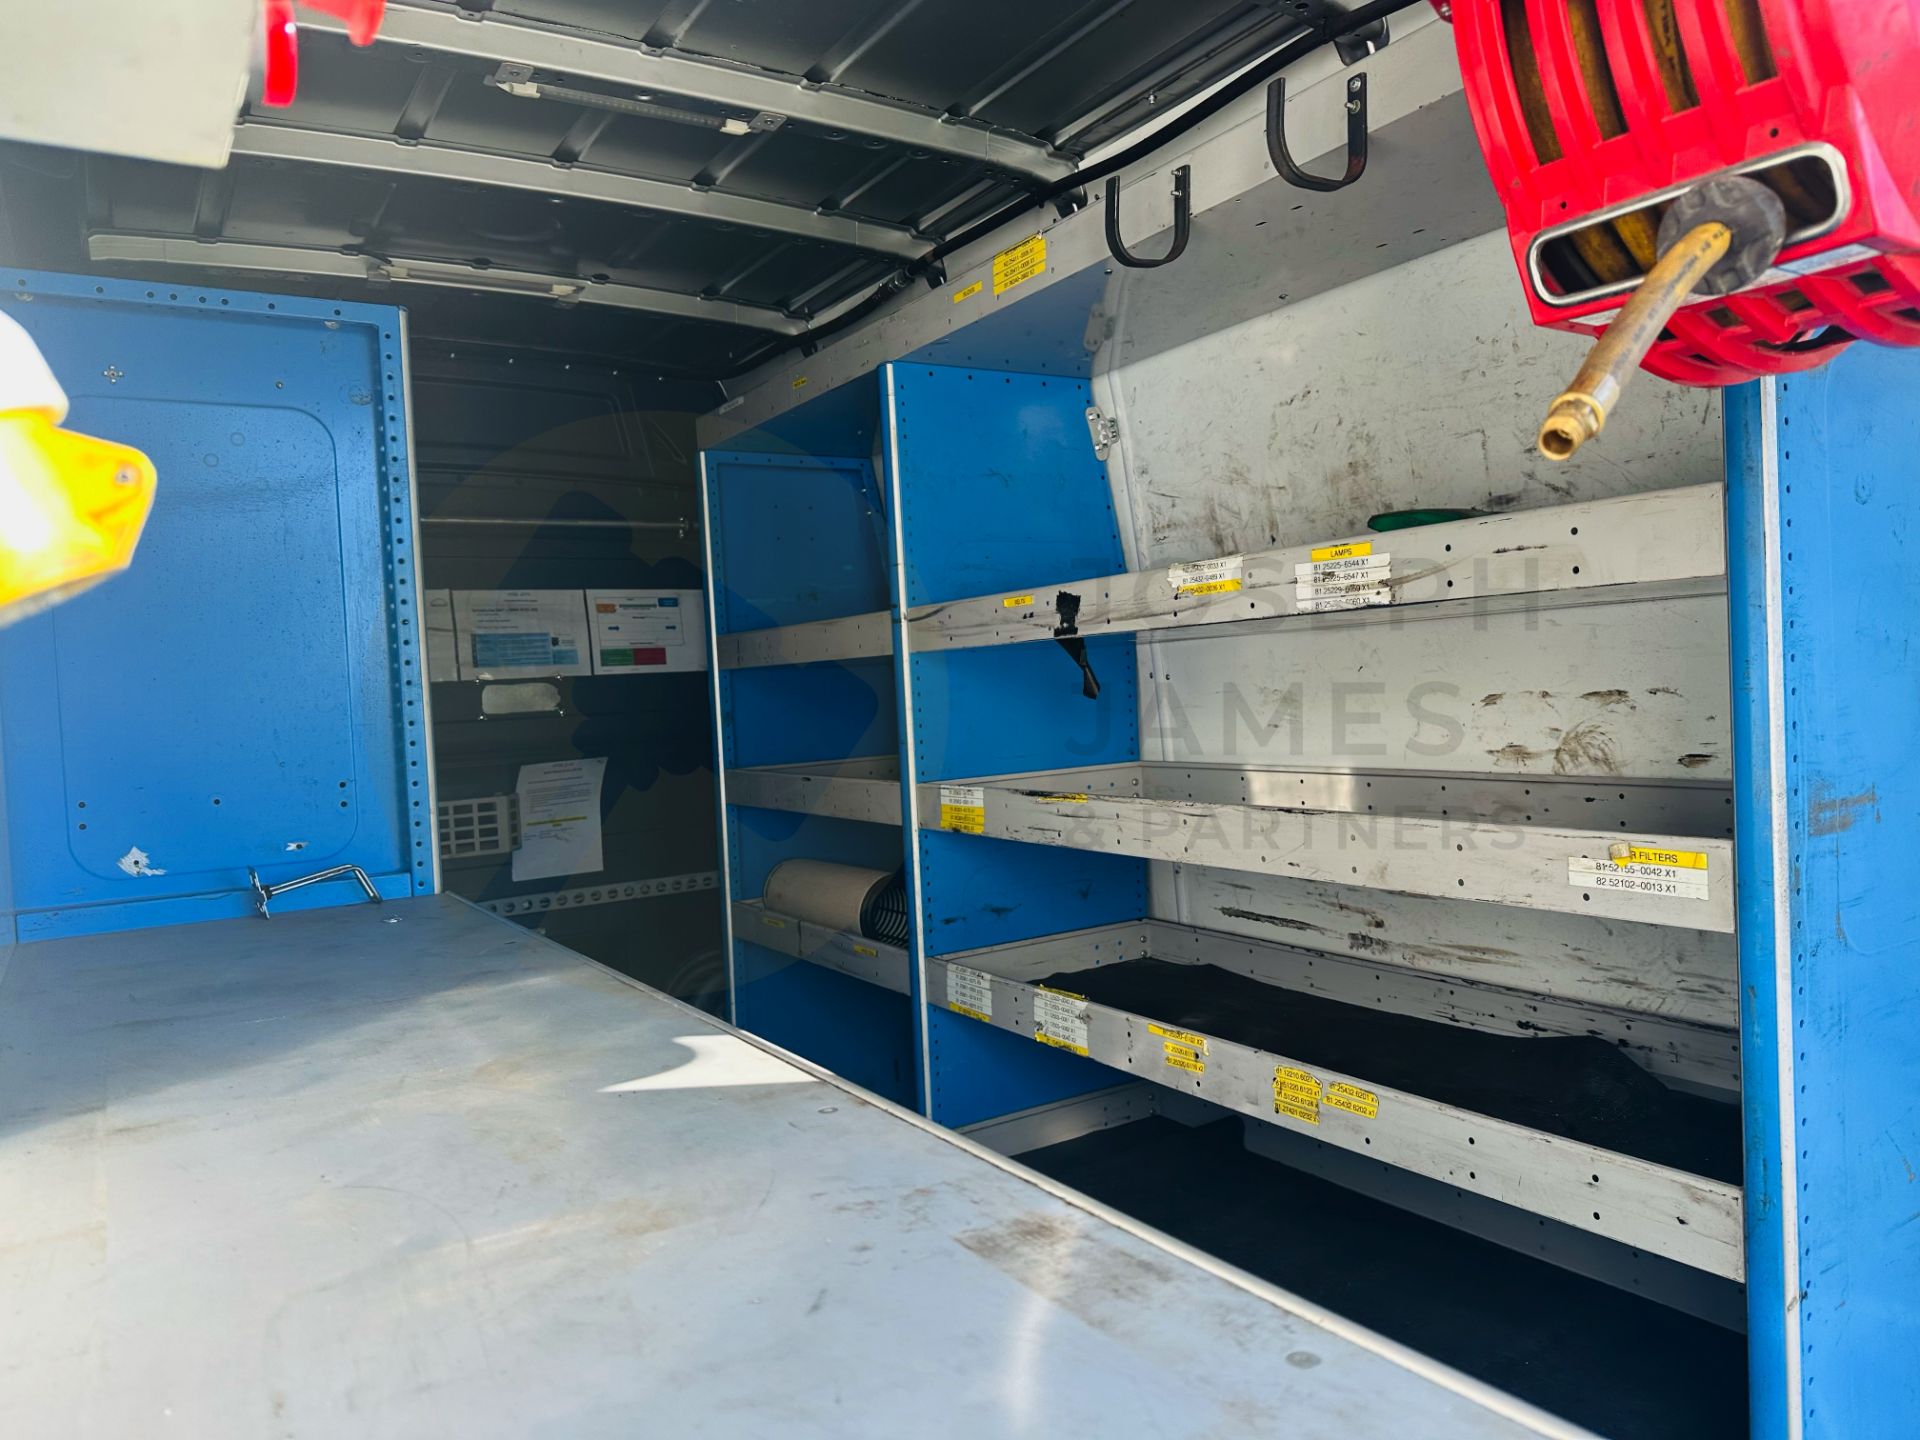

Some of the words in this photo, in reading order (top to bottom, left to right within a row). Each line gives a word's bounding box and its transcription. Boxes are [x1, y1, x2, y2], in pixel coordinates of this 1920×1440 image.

[1330, 548, 1352, 558] LAMPS
[1640, 852, 1678, 864] FILTERS
[1664, 870, 1676, 878] X1
[1596, 877, 1606, 886] 82
[1609, 878, 1663, 892] 52102-0013
[1665, 885, 1676, 894] X1
